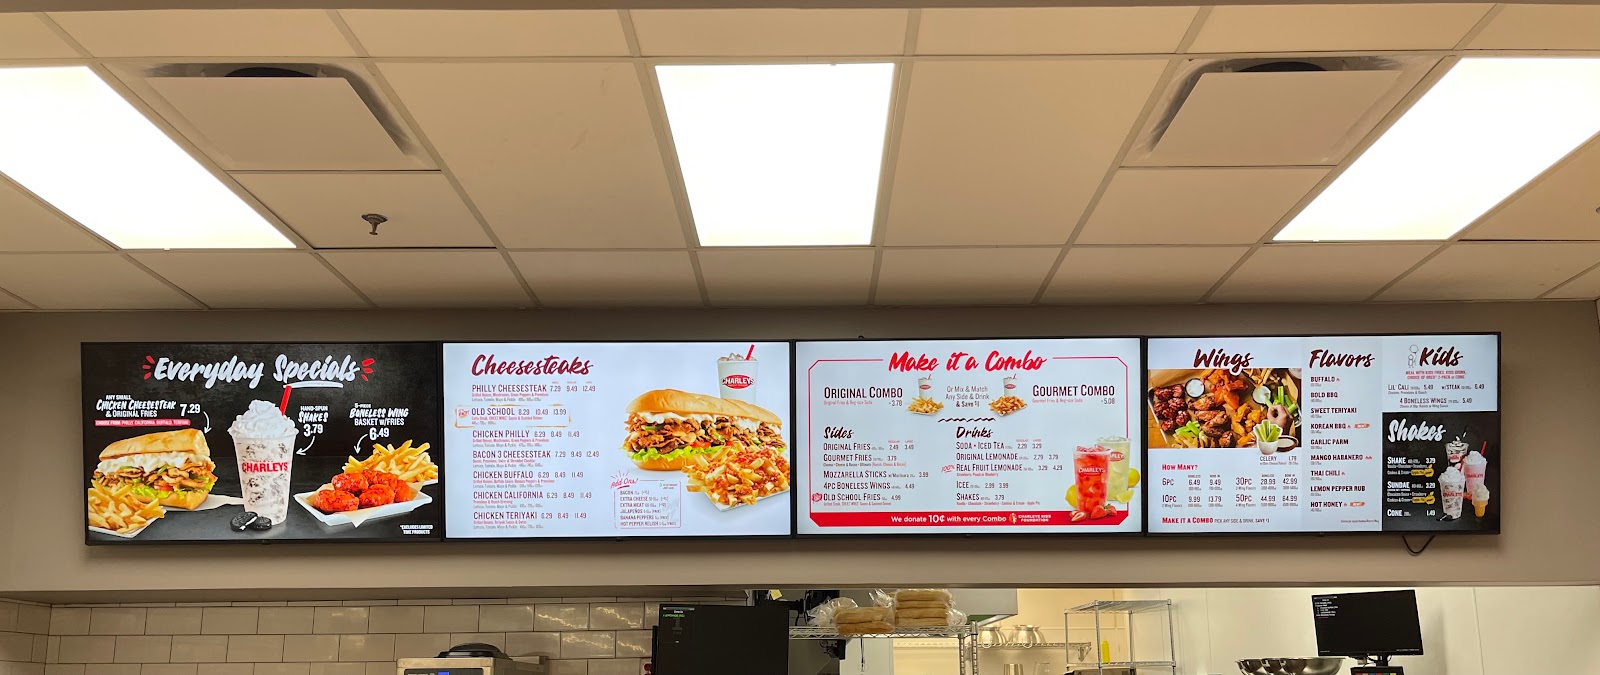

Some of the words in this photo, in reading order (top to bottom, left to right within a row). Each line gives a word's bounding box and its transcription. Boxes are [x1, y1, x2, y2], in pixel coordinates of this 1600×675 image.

[888, 351, 939, 372] Make
[946, 352, 968, 371] it
[964, 356, 979, 371] a
[985, 350, 1047, 371] Combo
[1194, 349, 1254, 373] Wings
[1309, 349, 1375, 368] Flavors
[1419, 346, 1463, 367] Kids
[471, 354, 594, 376] Cheesesteaks
[154, 356, 264, 389] Everyday
[273, 354, 360, 384] Specials
[824, 387, 866, 398] ORIGINAL
[869, 387, 903, 398] COMBO
[1032, 385, 1078, 396] GOURMET
[1080, 385, 1115, 396] COMBO
[96, 400, 126, 411] CHICKEN
[128, 400, 176, 411] CHEESESTEAK
[180, 404, 200, 416] 7.29
[298, 412, 328, 423] SHAKES
[349, 408, 386, 418] BONELESS
[388, 408, 409, 417] WING
[354, 418, 378, 426] BASKET
[304, 424, 323, 436] 3.79
[369, 427, 389, 441] 6.49
[824, 426, 854, 439] Sides
[956, 426, 994, 438] Drinks
[1388, 418, 1446, 442] Shakes
[242, 462, 288, 473] CHARLEYS
[1236, 477, 1252, 485] 30PC
[473, 491, 502, 499] CHICKEN
[504, 491, 543, 499] CALIFORNIA
[1236, 494, 1252, 502] 50PC
[928, 515, 945, 523] 10¢
